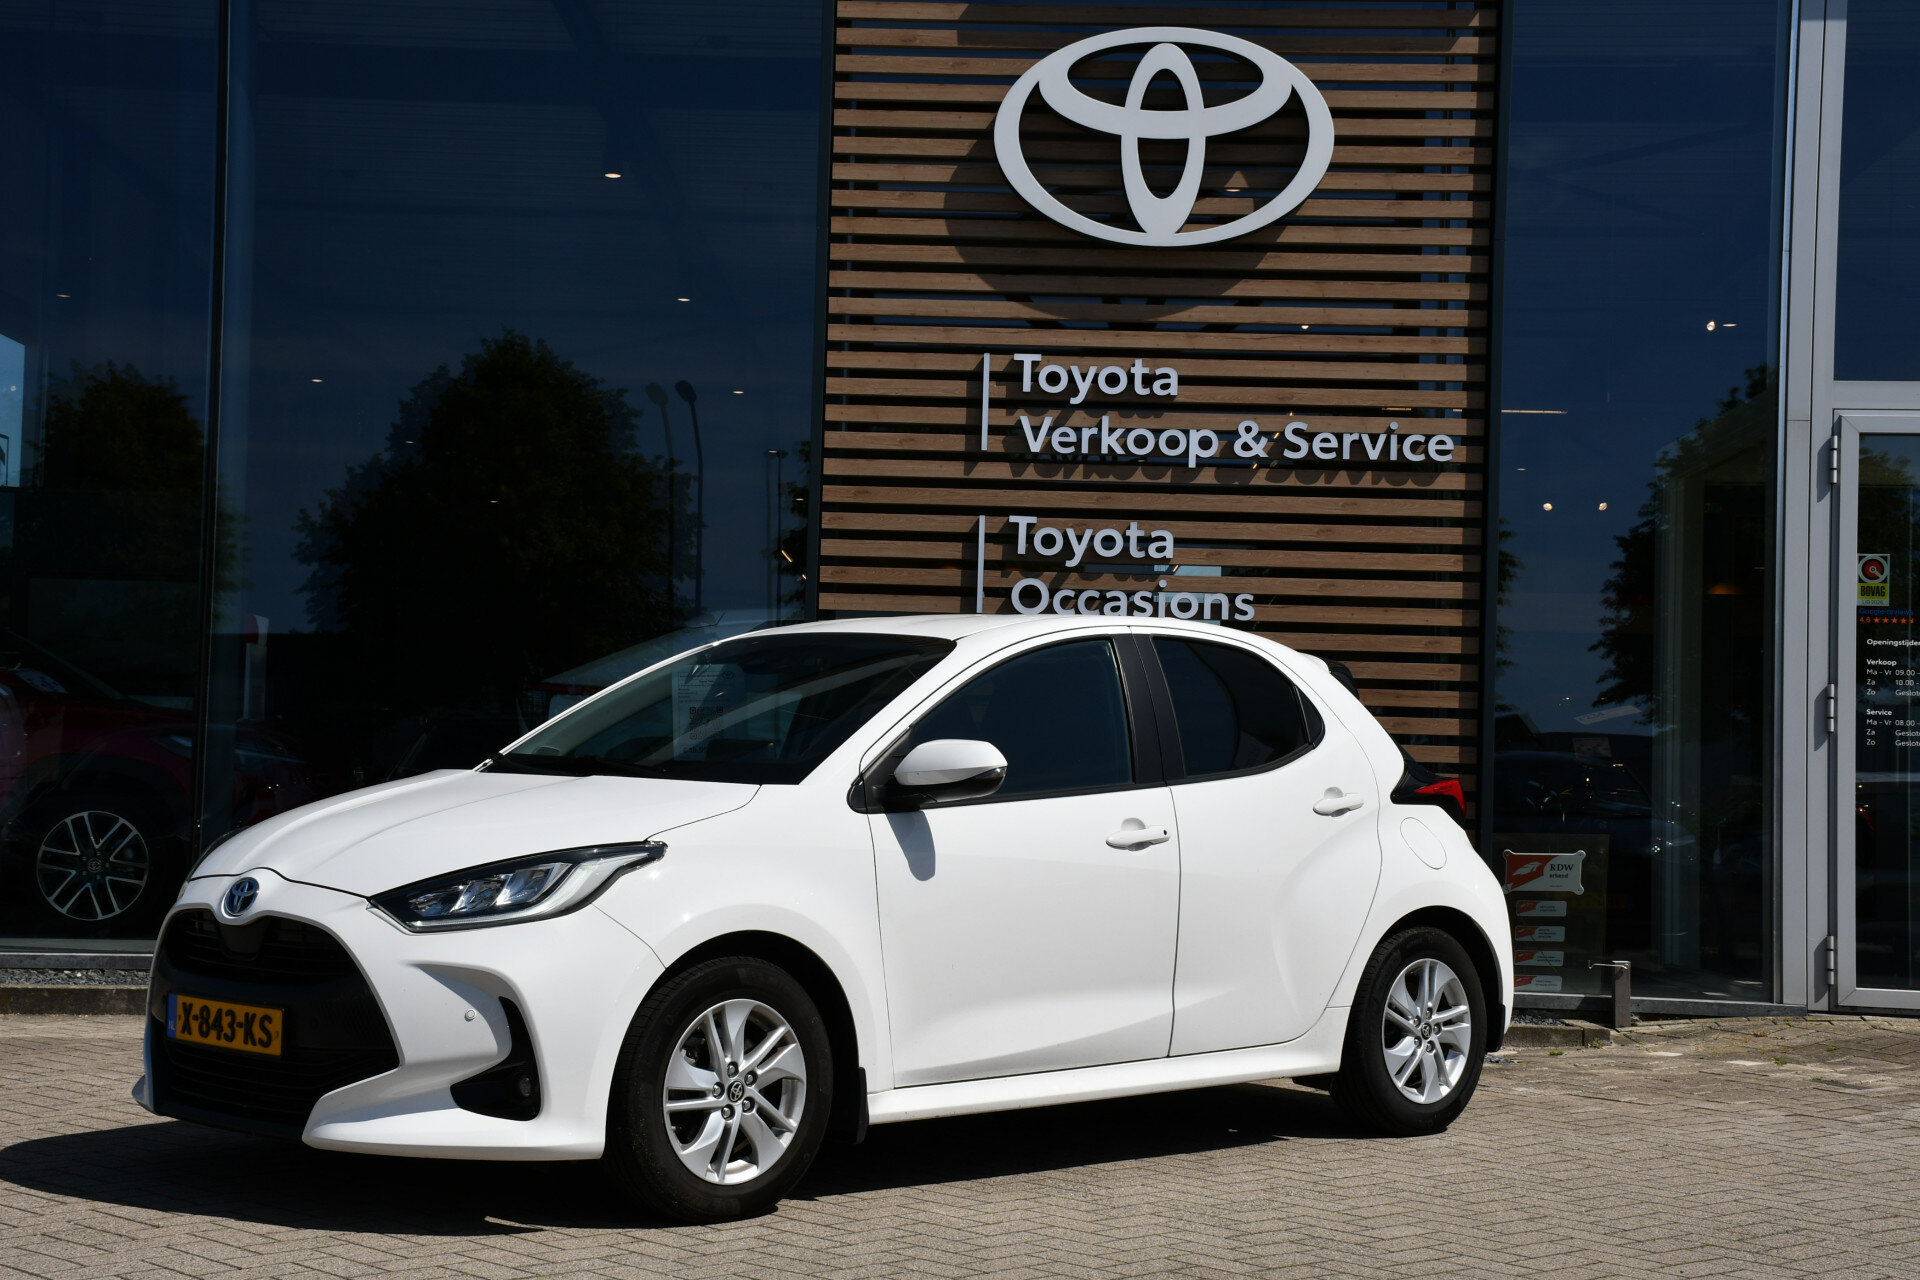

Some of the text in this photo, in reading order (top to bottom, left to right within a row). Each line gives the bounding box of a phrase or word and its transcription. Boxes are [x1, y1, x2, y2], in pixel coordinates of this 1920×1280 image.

[1014, 353, 1179, 404] Toyota
[1020, 415, 1455, 468] Verkoop & Service
[1009, 515, 1175, 567] Toyota
[1861, 585, 1886, 597] BOVAG
[1011, 577, 1256, 621] Occasions
[1866, 658, 1897, 667] Verkoop
[1866, 668, 1878, 676] Ma
[1895, 679, 1915, 687] 10.00
[1866, 708, 1892, 717] Service
[1895, 719, 1916, 727] 08.00
[1549, 863, 1574, 871] RDW
[180, 1001, 273, 1049] X-843-KS
